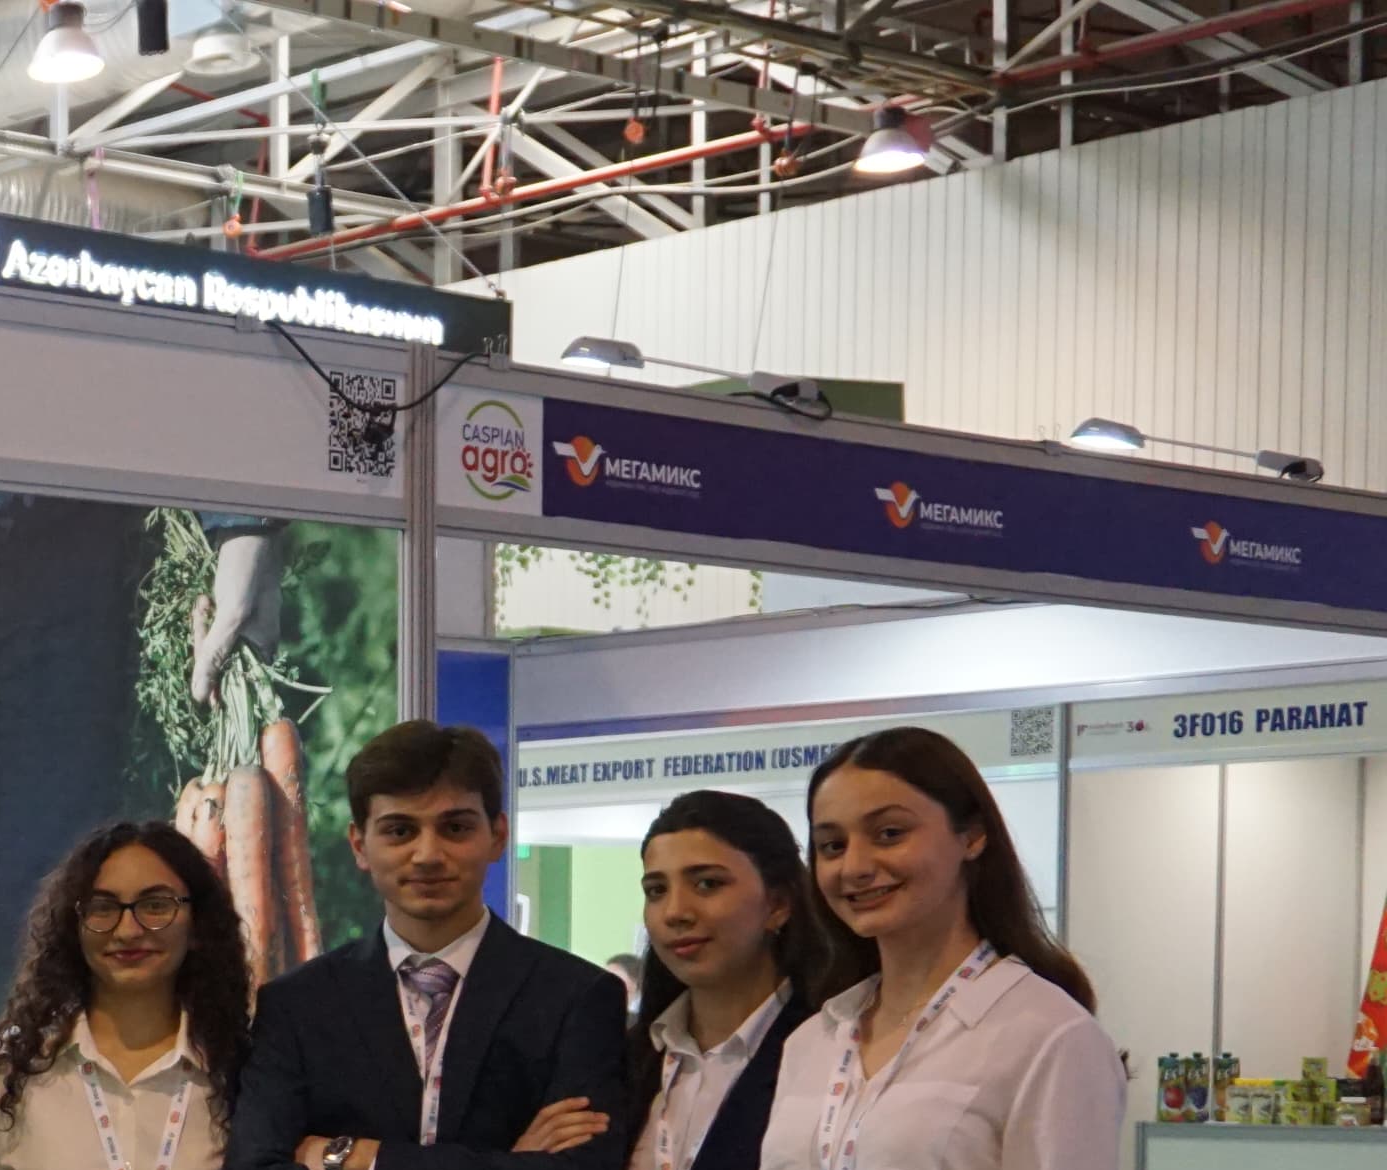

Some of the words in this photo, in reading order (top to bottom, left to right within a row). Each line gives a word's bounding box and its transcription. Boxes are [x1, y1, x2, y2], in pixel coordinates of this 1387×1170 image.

[462, 423, 525, 451] CASPIAN
[461, 445, 529, 483] agro
[605, 457, 701, 488] МЕГАМИКС
[920, 501, 1004, 529] МЕГАМИКС
[1229, 539, 1302, 565] МЕГАМИКС
[1255, 701, 1368, 733] PARAHAT
[593, 758, 655, 782] EXPORT
[663, 750, 766, 777] FEDERATION
